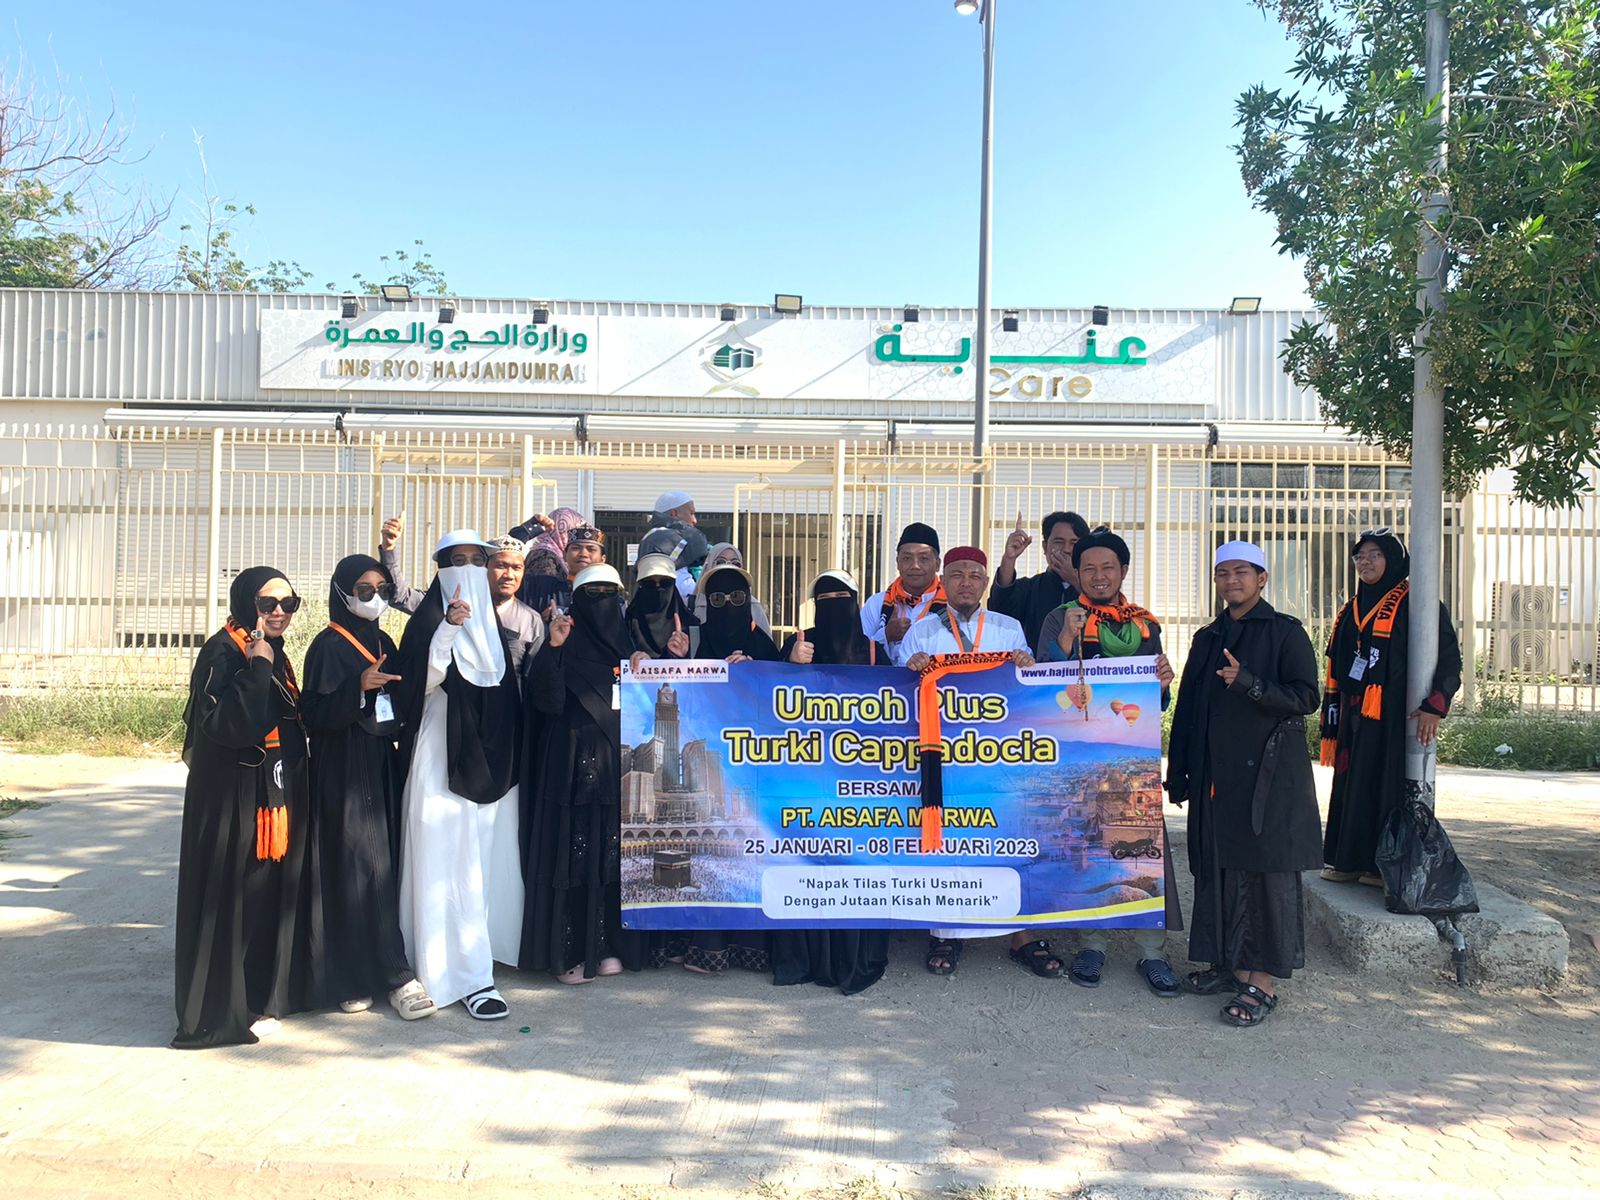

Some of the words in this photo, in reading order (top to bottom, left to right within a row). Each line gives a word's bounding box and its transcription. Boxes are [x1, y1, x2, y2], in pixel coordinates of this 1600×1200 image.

[325, 320, 444, 351] والعمرة
[450, 324, 519, 351] الحج
[524, 324, 588, 354] وزارة
[875, 323, 1147, 375] عنية
[640, 666, 682, 675] AISAFA
[687, 666, 727, 675] MARWA
[774, 687, 908, 722] Umroh
[722, 729, 823, 764] Turki
[837, 781, 923, 796] BERSAM
[781, 807, 815, 828] PT.
[819, 807, 903, 828] AISAFA
[907, 807, 998, 828] MRWA
[745, 839, 765, 855] 25
[770, 839, 851, 855] JANUARI
[868, 839, 889, 855] 08
[894, 838, 989, 855] FEUARi
[995, 839, 1037, 856] 2023
[853, 878, 887, 889] Tilas
[891, 877, 926, 889] Turki
[930, 878, 983, 889] Usmani
[784, 895, 836, 908] Dengan
[840, 895, 888, 906] Jutaan
[891, 895, 931, 906] Kisah
